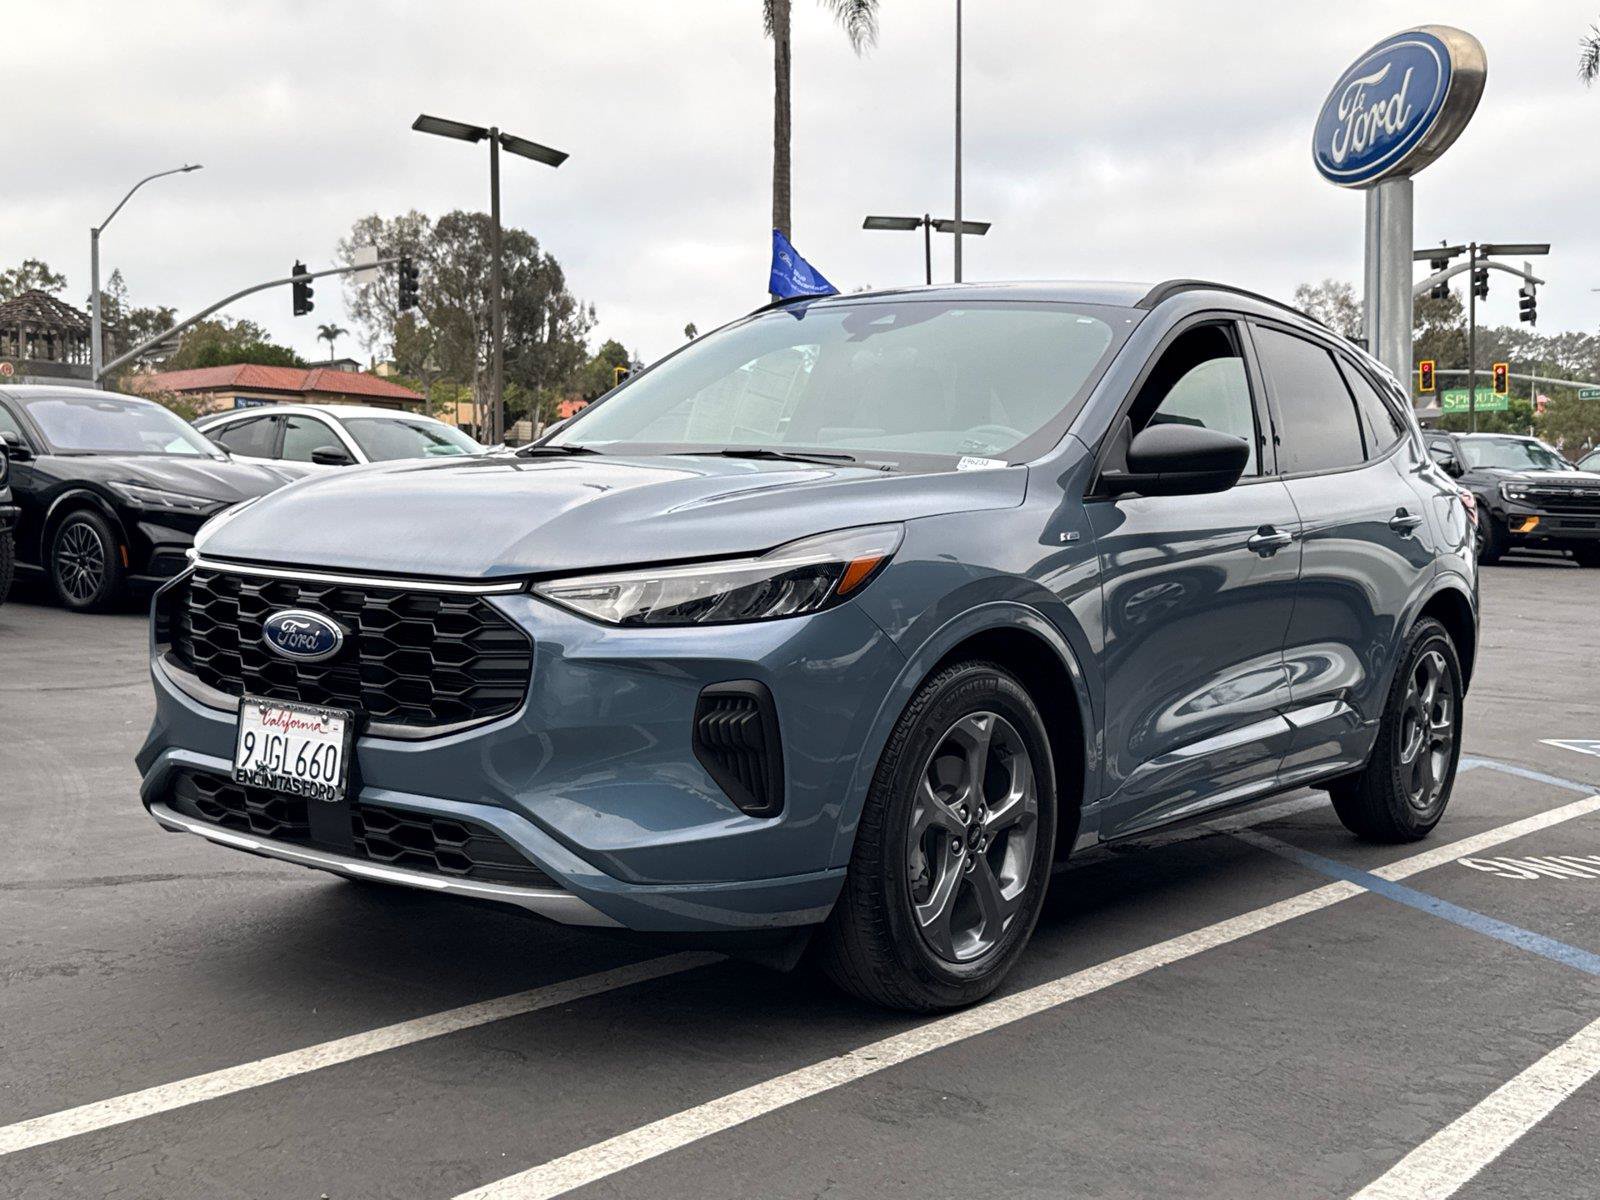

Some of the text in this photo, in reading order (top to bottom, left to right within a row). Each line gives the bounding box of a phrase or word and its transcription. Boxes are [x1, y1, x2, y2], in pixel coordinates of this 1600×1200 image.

[1331, 62, 1414, 164] Ford
[277, 619, 321, 650] Ford
[260, 707, 328, 734] California
[241, 731, 338, 783] 9JGL660
[236, 768, 336, 801] ENCINITAS FORD
